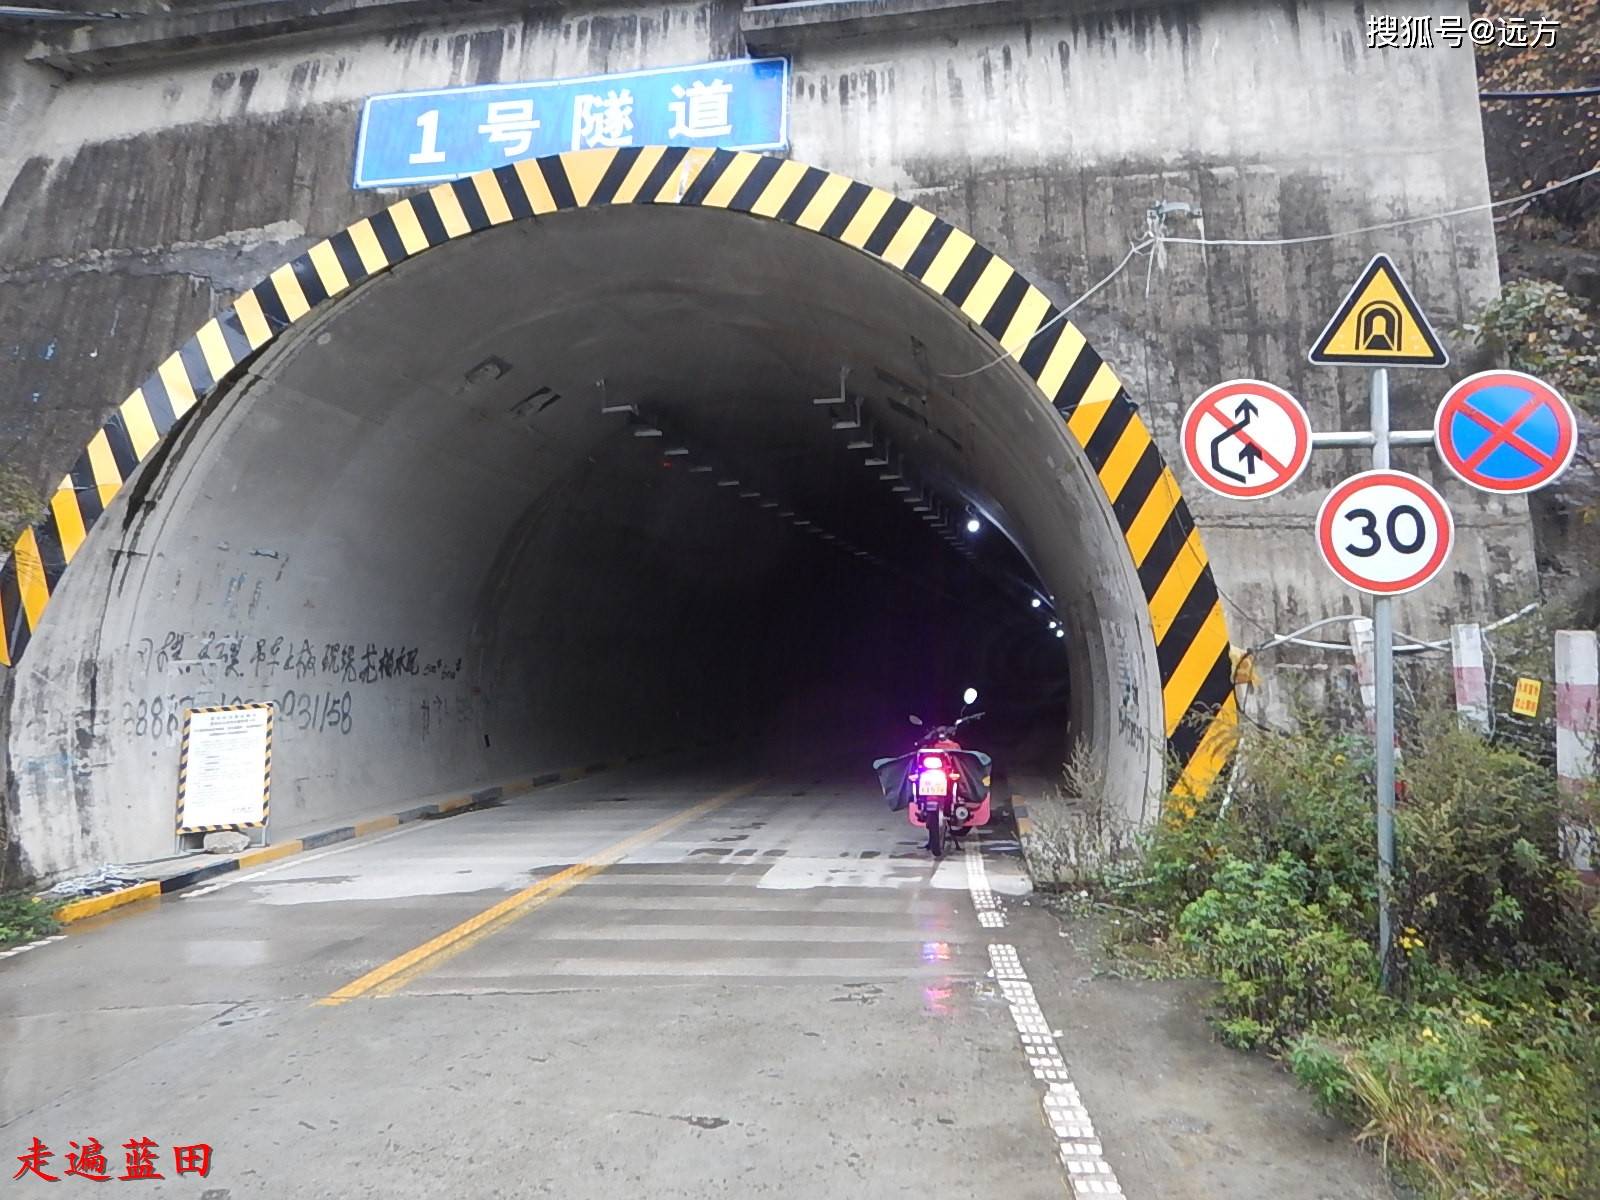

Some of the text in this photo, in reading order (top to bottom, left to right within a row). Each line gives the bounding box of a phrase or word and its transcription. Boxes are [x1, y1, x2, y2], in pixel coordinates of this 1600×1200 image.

[408, 79, 734, 165] 1号隧道
[1344, 504, 1426, 558] 30
